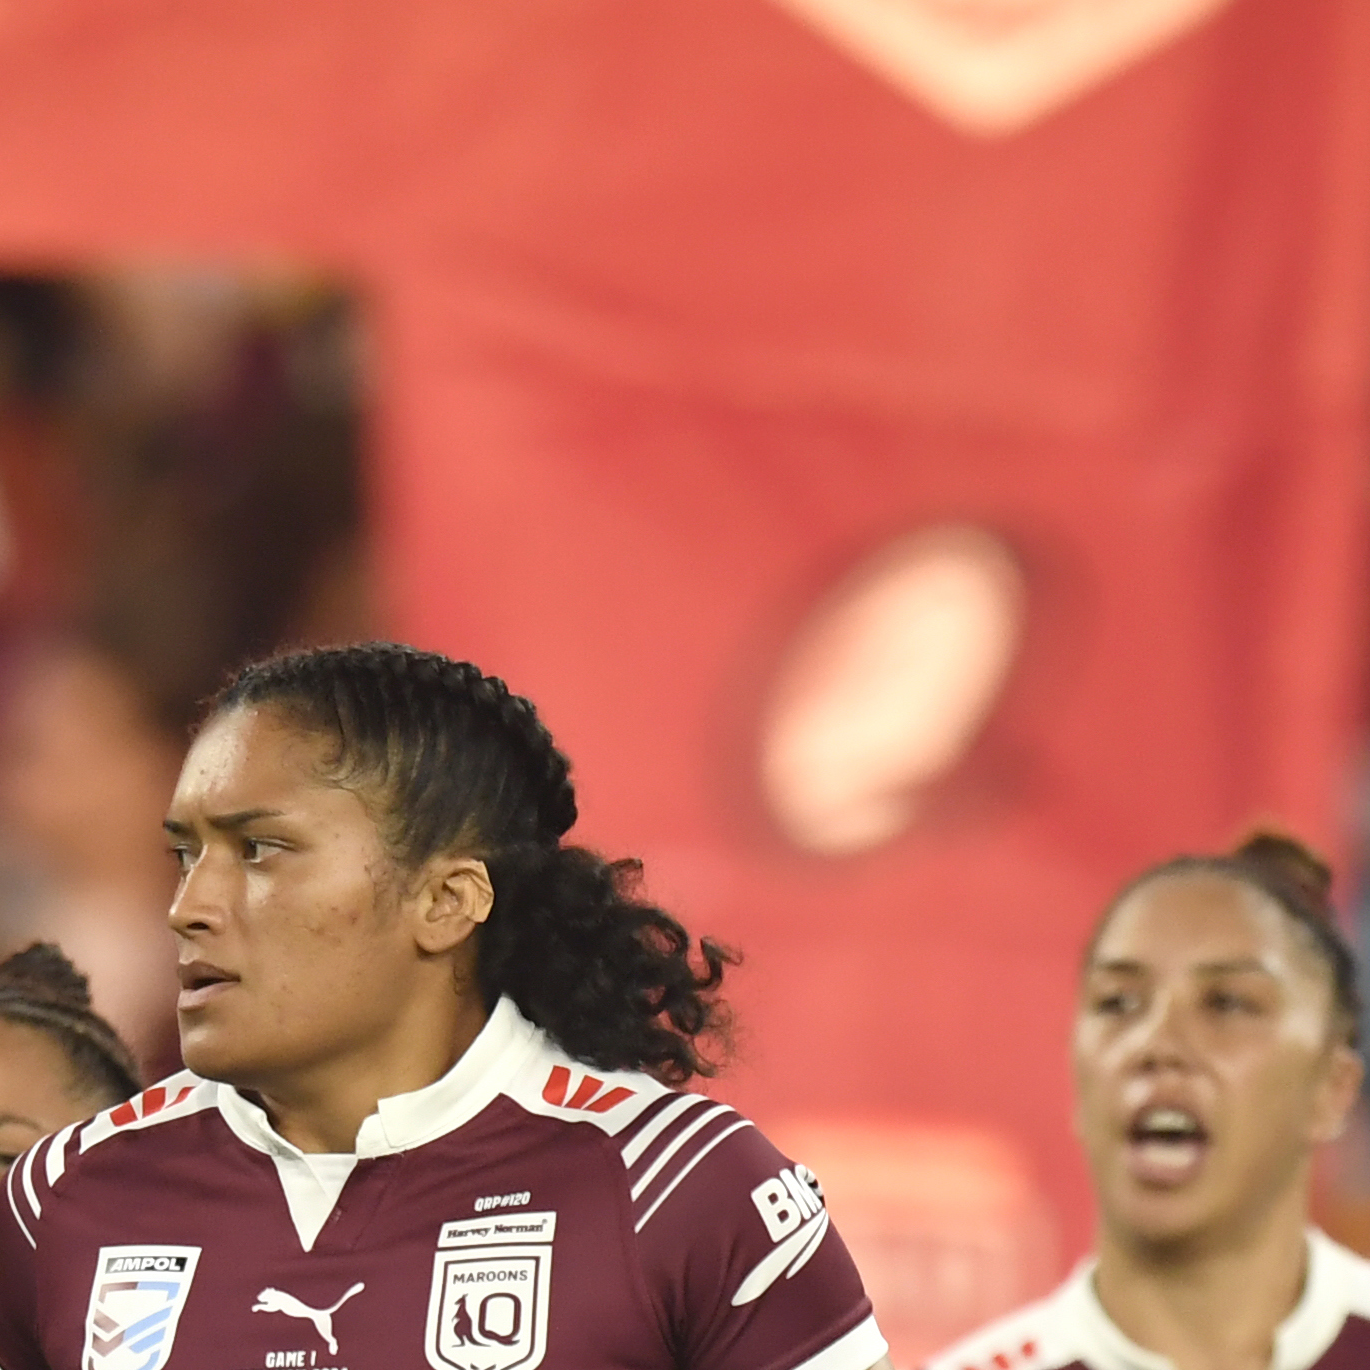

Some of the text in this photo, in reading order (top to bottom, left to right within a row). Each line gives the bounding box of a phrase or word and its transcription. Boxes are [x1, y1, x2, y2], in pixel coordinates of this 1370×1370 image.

[446, 1227, 492, 1239] Harvey
[110, 1257, 181, 1272] AMPOL
[452, 1270, 529, 1285] MAROONS
[265, 1350, 307, 1369] GAME
